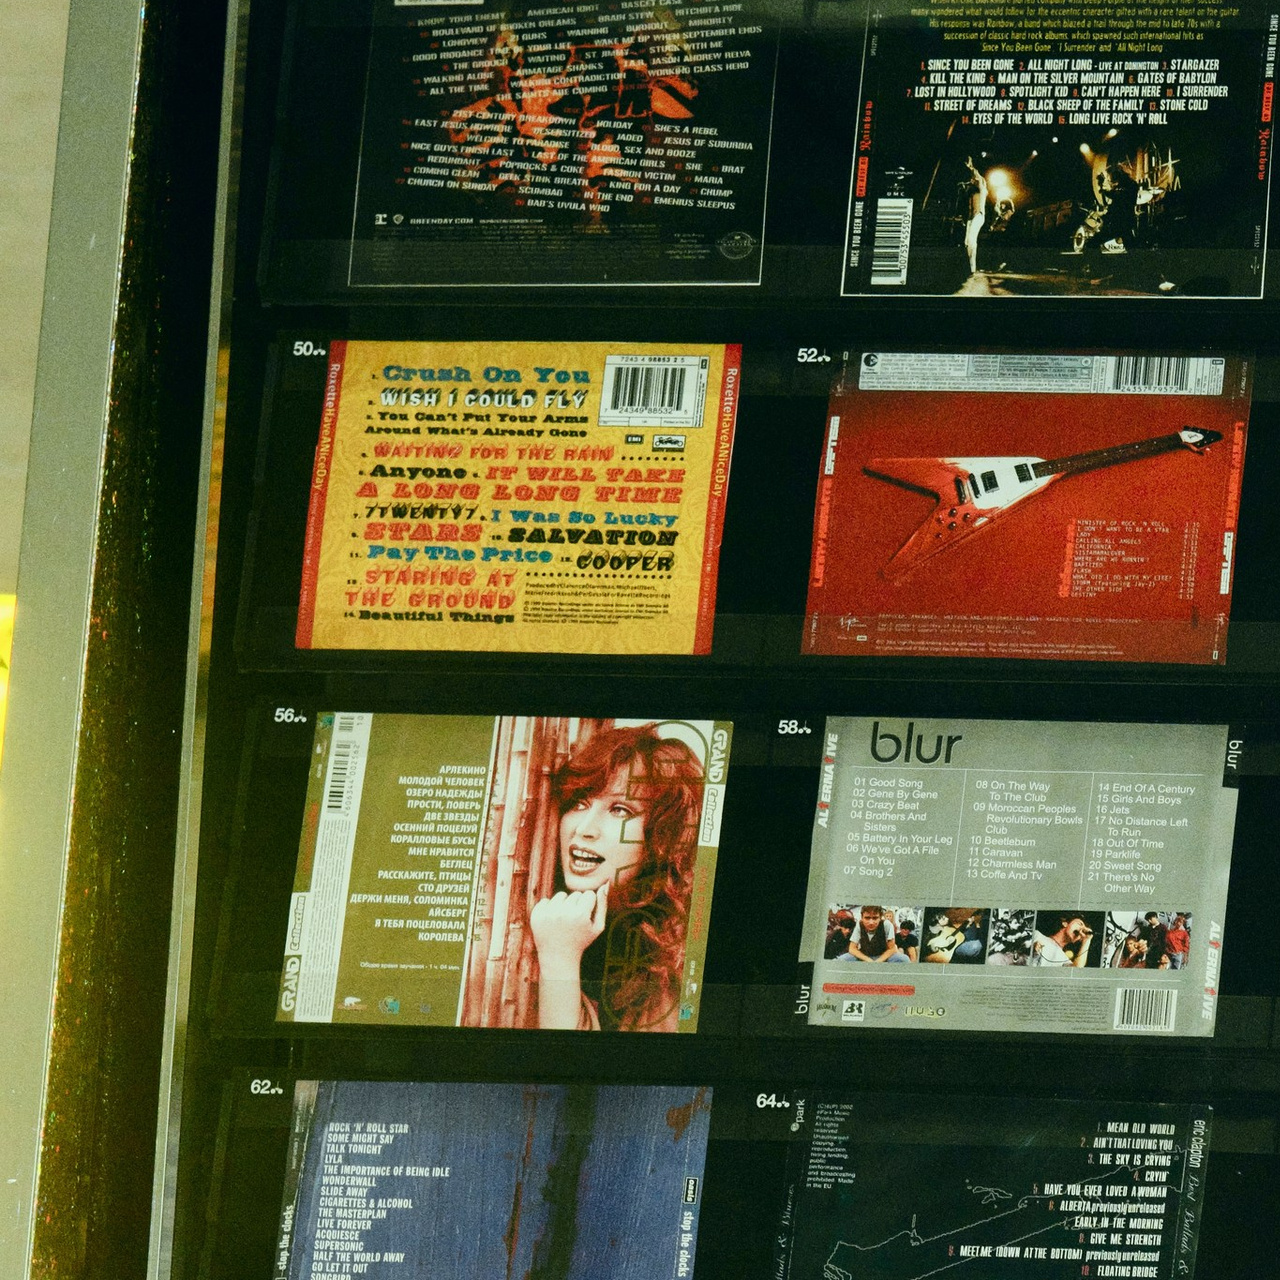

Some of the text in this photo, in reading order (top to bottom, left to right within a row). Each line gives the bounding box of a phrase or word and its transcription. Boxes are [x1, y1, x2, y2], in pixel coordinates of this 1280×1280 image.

[927, 58, 1015, 71] SINCE YOU BEEN GONE
[1170, 58, 1220, 71] STARGAZER
[293, 342, 313, 356] 50
[797, 348, 818, 363] 52
[382, 364, 591, 384] Crush On You
[381, 387, 589, 408] WISH I COULD FLY
[377, 411, 589, 424] You Can't Put Your Arms
[369, 464, 467, 480] Anyone
[485, 466, 686, 483] IT WILL TAKE
[355, 481, 683, 504] A LONG LONG TIME
[363, 522, 483, 543] STARS
[507, 527, 679, 547] SALVATION
[367, 544, 553, 563] Pay The Price
[576, 551, 675, 572] COOPER
[274, 708, 294, 723] 56
[777, 720, 798, 735] 58
[870, 721, 963, 764] blur
[1226, 739, 1243, 769] blur
[439, 766, 486, 775] АРЛЕКИНО
[853, 777, 924, 790] 01 Good Song
[1098, 783, 1196, 797] 14 End Of A Century
[406, 788, 483, 799] ОЗЕРО НАДЕЖДЫ
[418, 932, 464, 942] КОРОЛЕВА
[794, 984, 810, 1015] blur
[250, 1080, 271, 1095] 62
[756, 1094, 777, 1109] 64
[329, 1122, 351, 1134] ROCK
[366, 1123, 387, 1135] ROLL
[389, 1123, 409, 1135] STAR
[322, 1176, 377, 1188] WONDERWALL
[317, 1219, 372, 1231] LIVE FOREVER
[277, 1205, 294, 1271] stop the clocks
